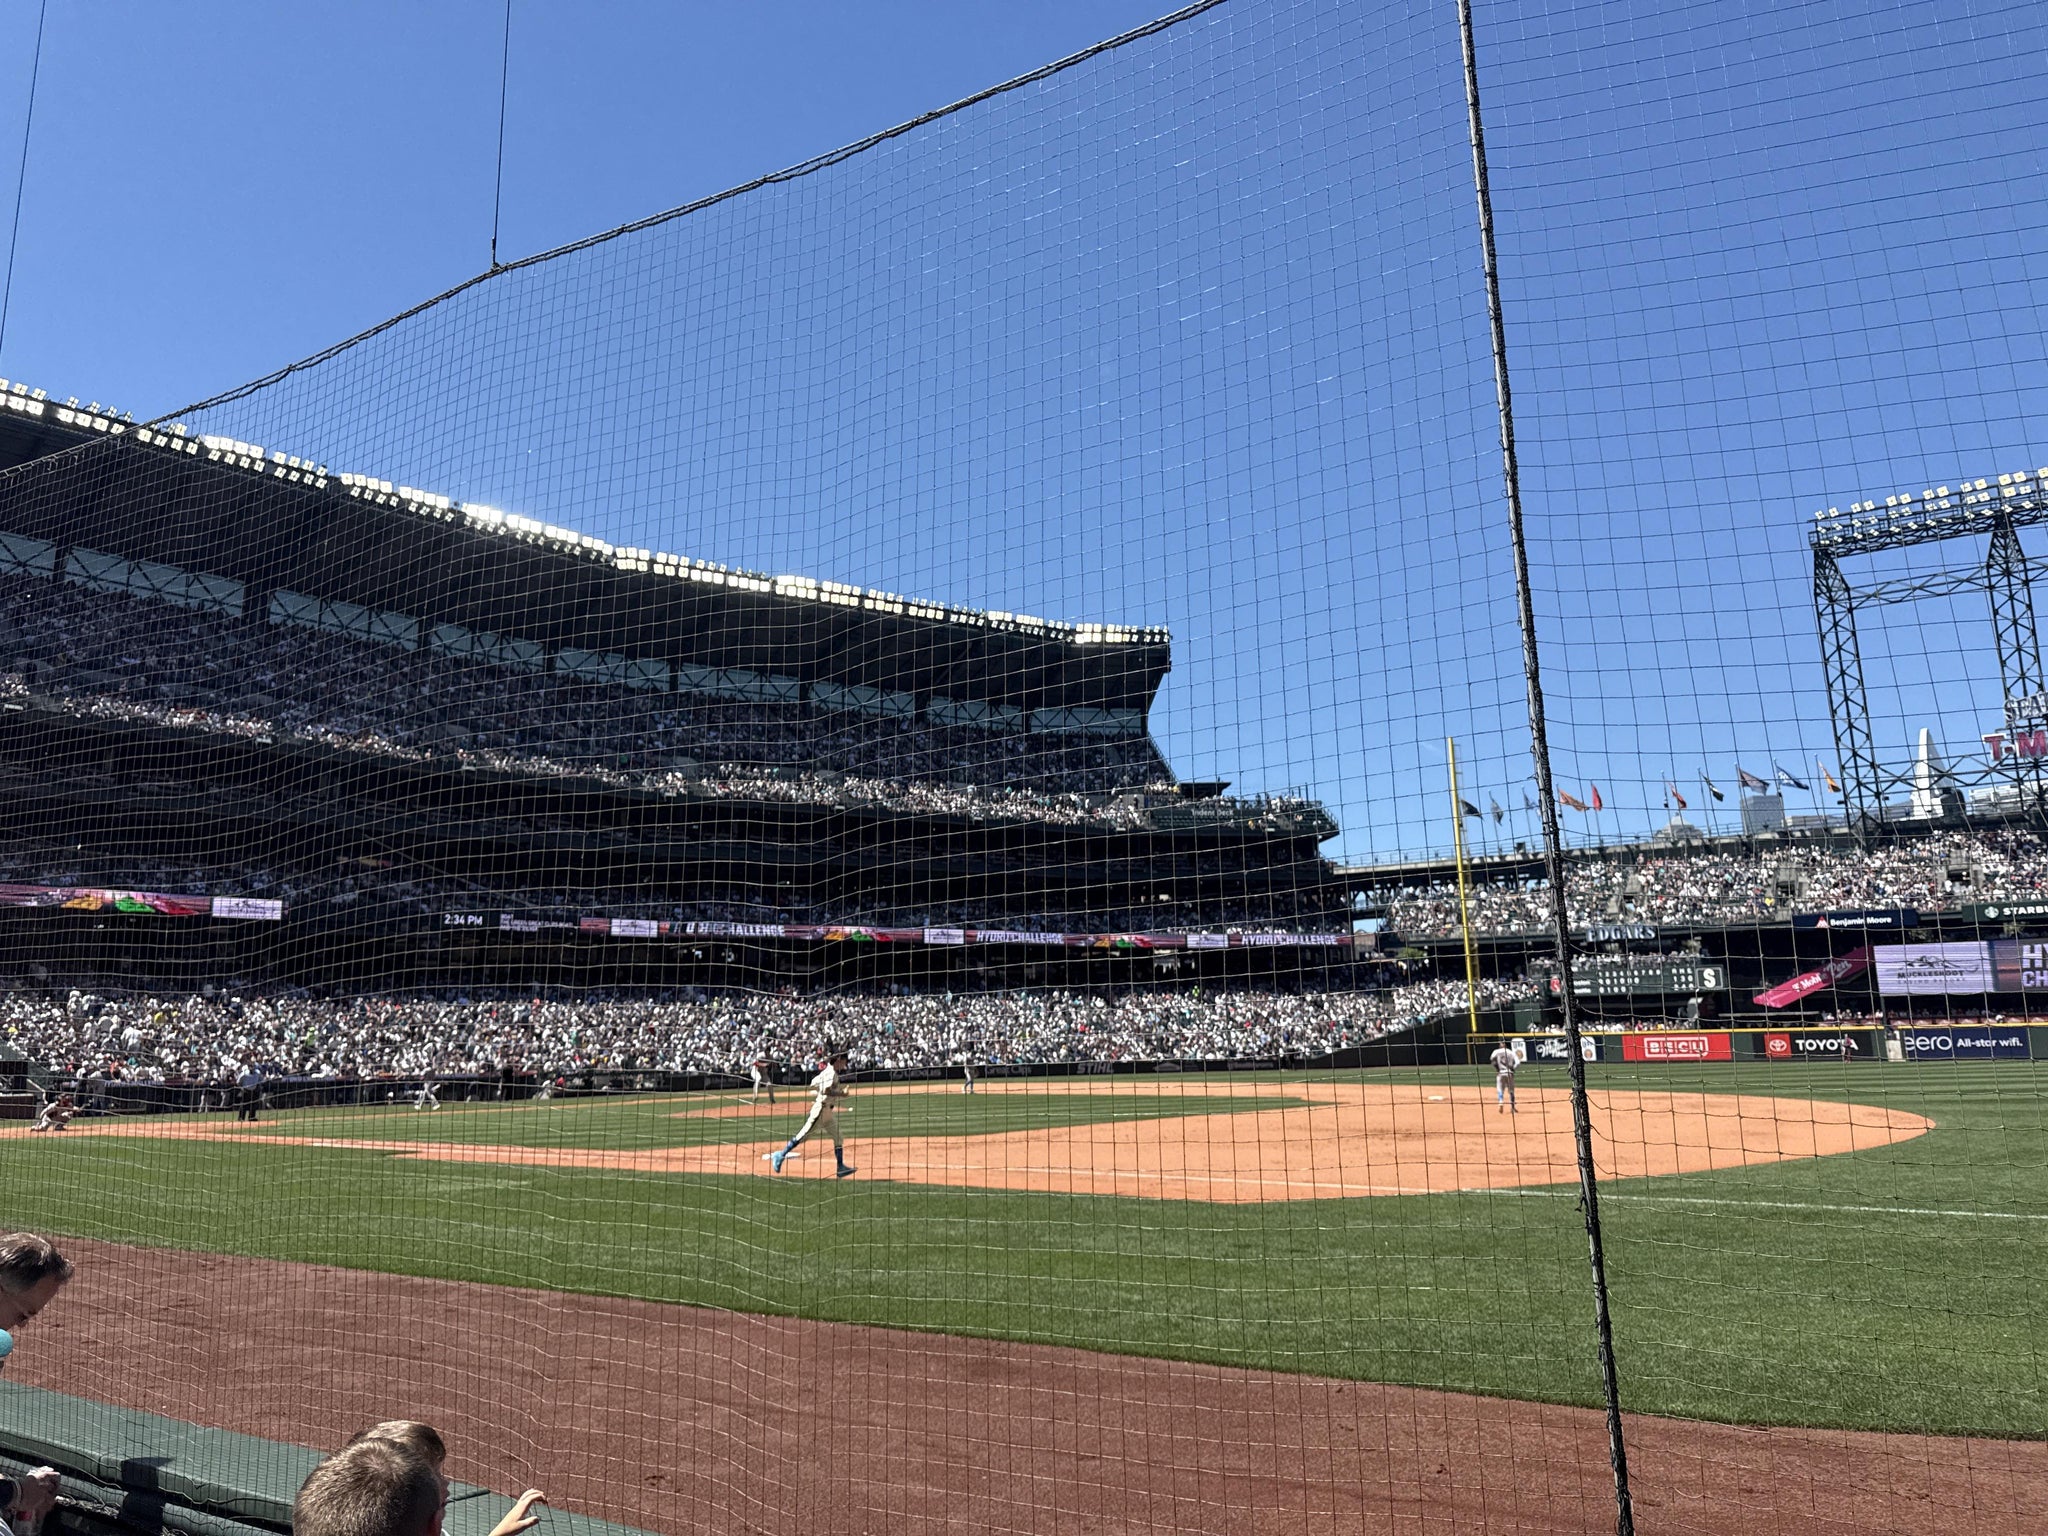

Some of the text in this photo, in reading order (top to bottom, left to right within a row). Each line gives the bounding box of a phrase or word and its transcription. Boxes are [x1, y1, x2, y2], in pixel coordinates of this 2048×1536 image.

[444, 914, 483, 925] 2:34 PM
[1830, 916, 1892, 927] Benjamin Moore
[1703, 968, 1716, 988] S
[1897, 969, 1965, 979] MUCKLESHOOT
[1649, 1041, 1704, 1054] BECU
[1795, 1039, 1859, 1051] TOYOTA
[1904, 1036, 2024, 1050] eero All-star wifi.
[1076, 1062, 1114, 1074] STIHL
